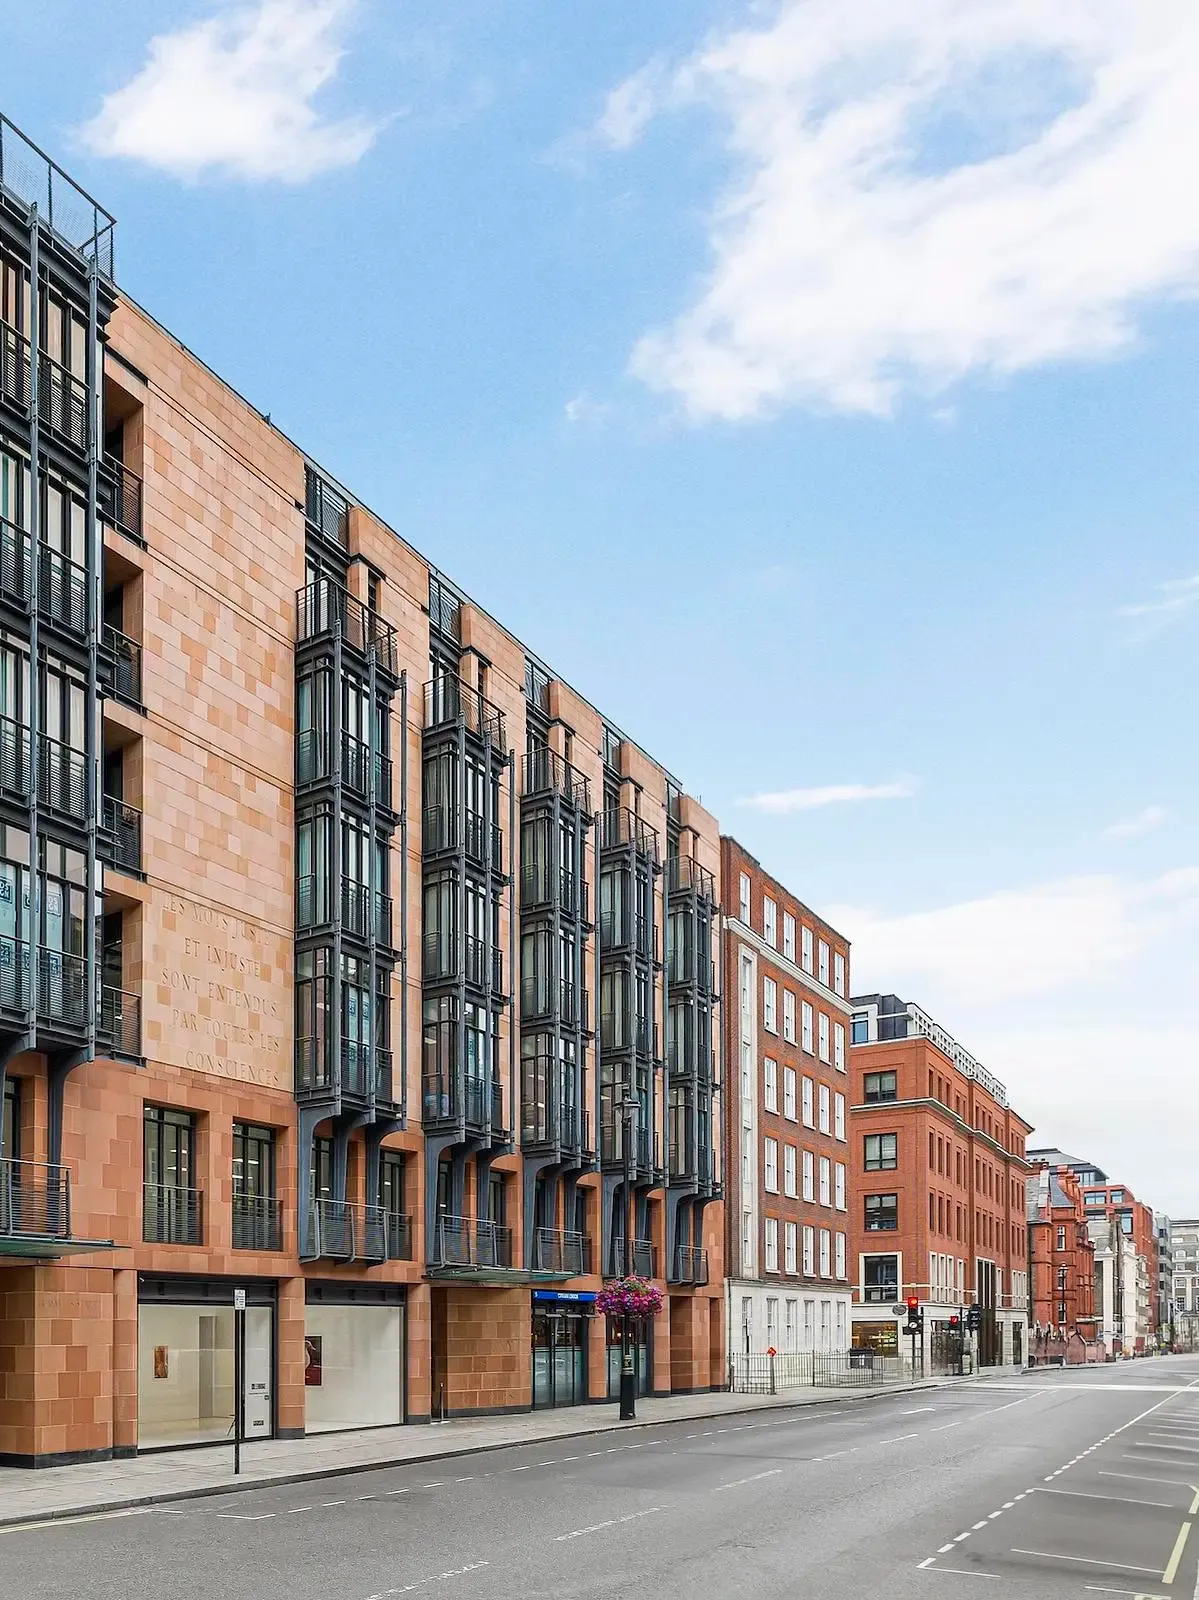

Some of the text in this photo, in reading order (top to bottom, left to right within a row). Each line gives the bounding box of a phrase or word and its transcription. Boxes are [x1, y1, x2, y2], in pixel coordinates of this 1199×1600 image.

[184, 937, 260, 977] ET INJUSTE
[161, 968, 277, 1017] SONT ENTENDUS
[173, 1008, 198, 1032] PAR
[260, 1033, 280, 1053] LES
[186, 1050, 279, 1088] CONSCIENCES
